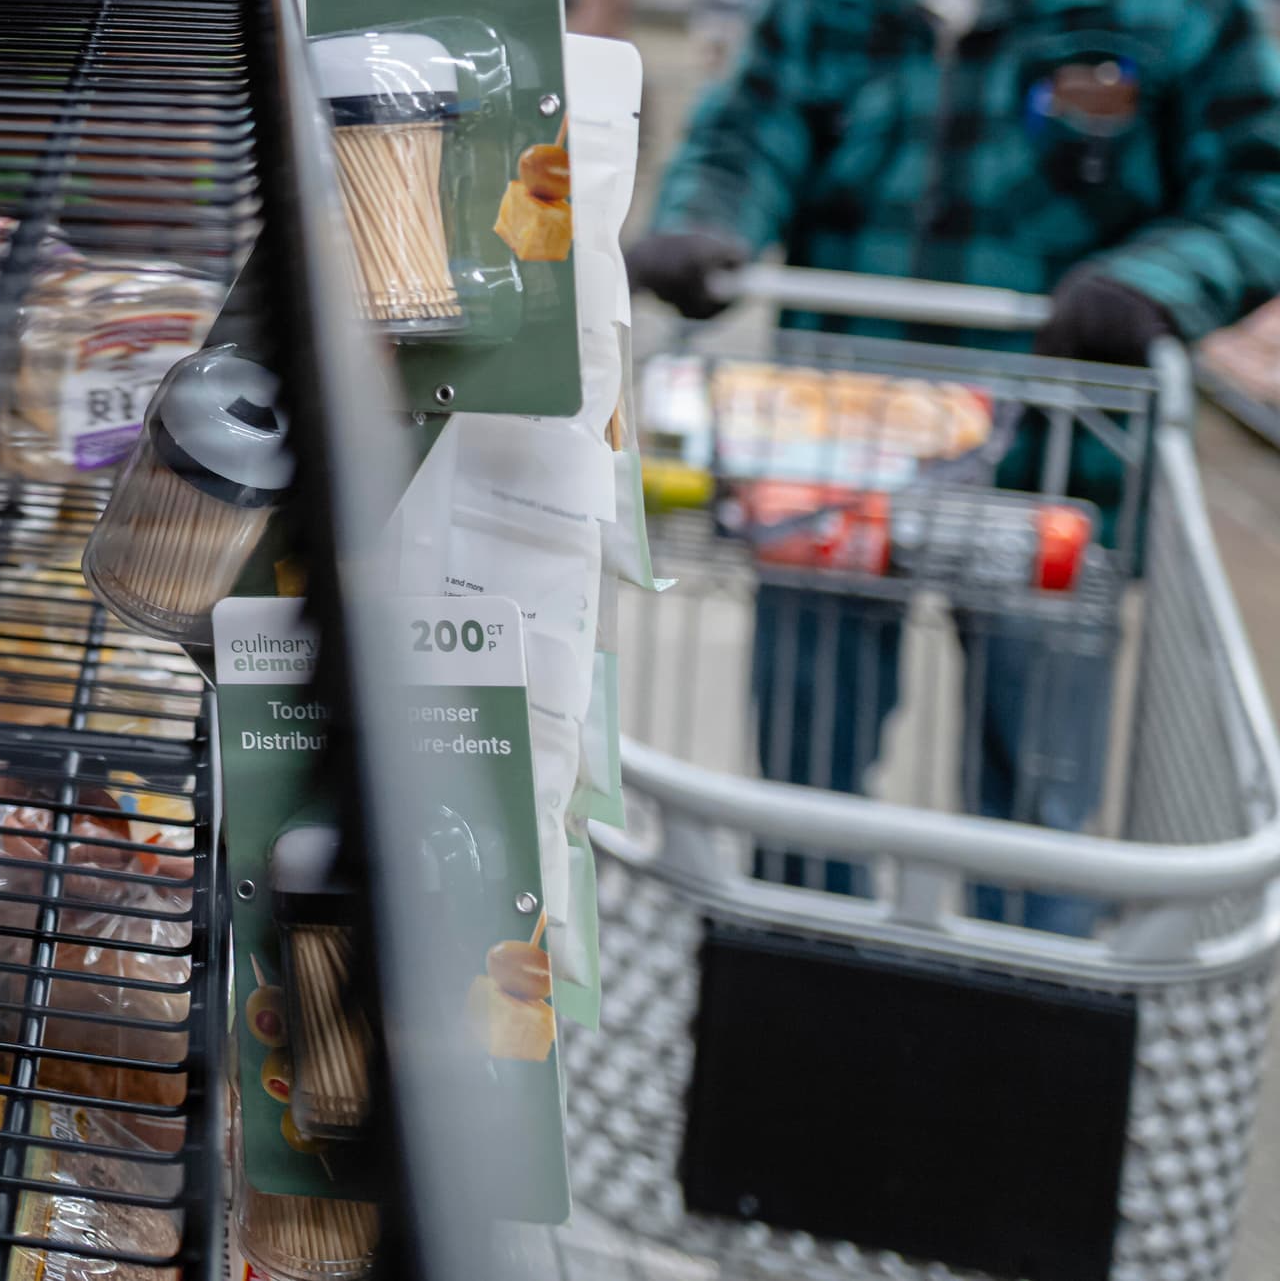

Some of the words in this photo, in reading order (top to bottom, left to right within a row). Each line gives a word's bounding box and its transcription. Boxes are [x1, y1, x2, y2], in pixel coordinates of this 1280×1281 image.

[450, 577, 465, 587] and
[465, 581, 484, 593] more
[231, 633, 319, 655] culinary
[410, 619, 485, 653] 200
[486, 624, 504, 637] CT
[488, 640, 497, 652] P
[233, 654, 315, 672] elemen
[241, 731, 327, 751] Distribut
[412, 735, 512, 755] ure-dents
